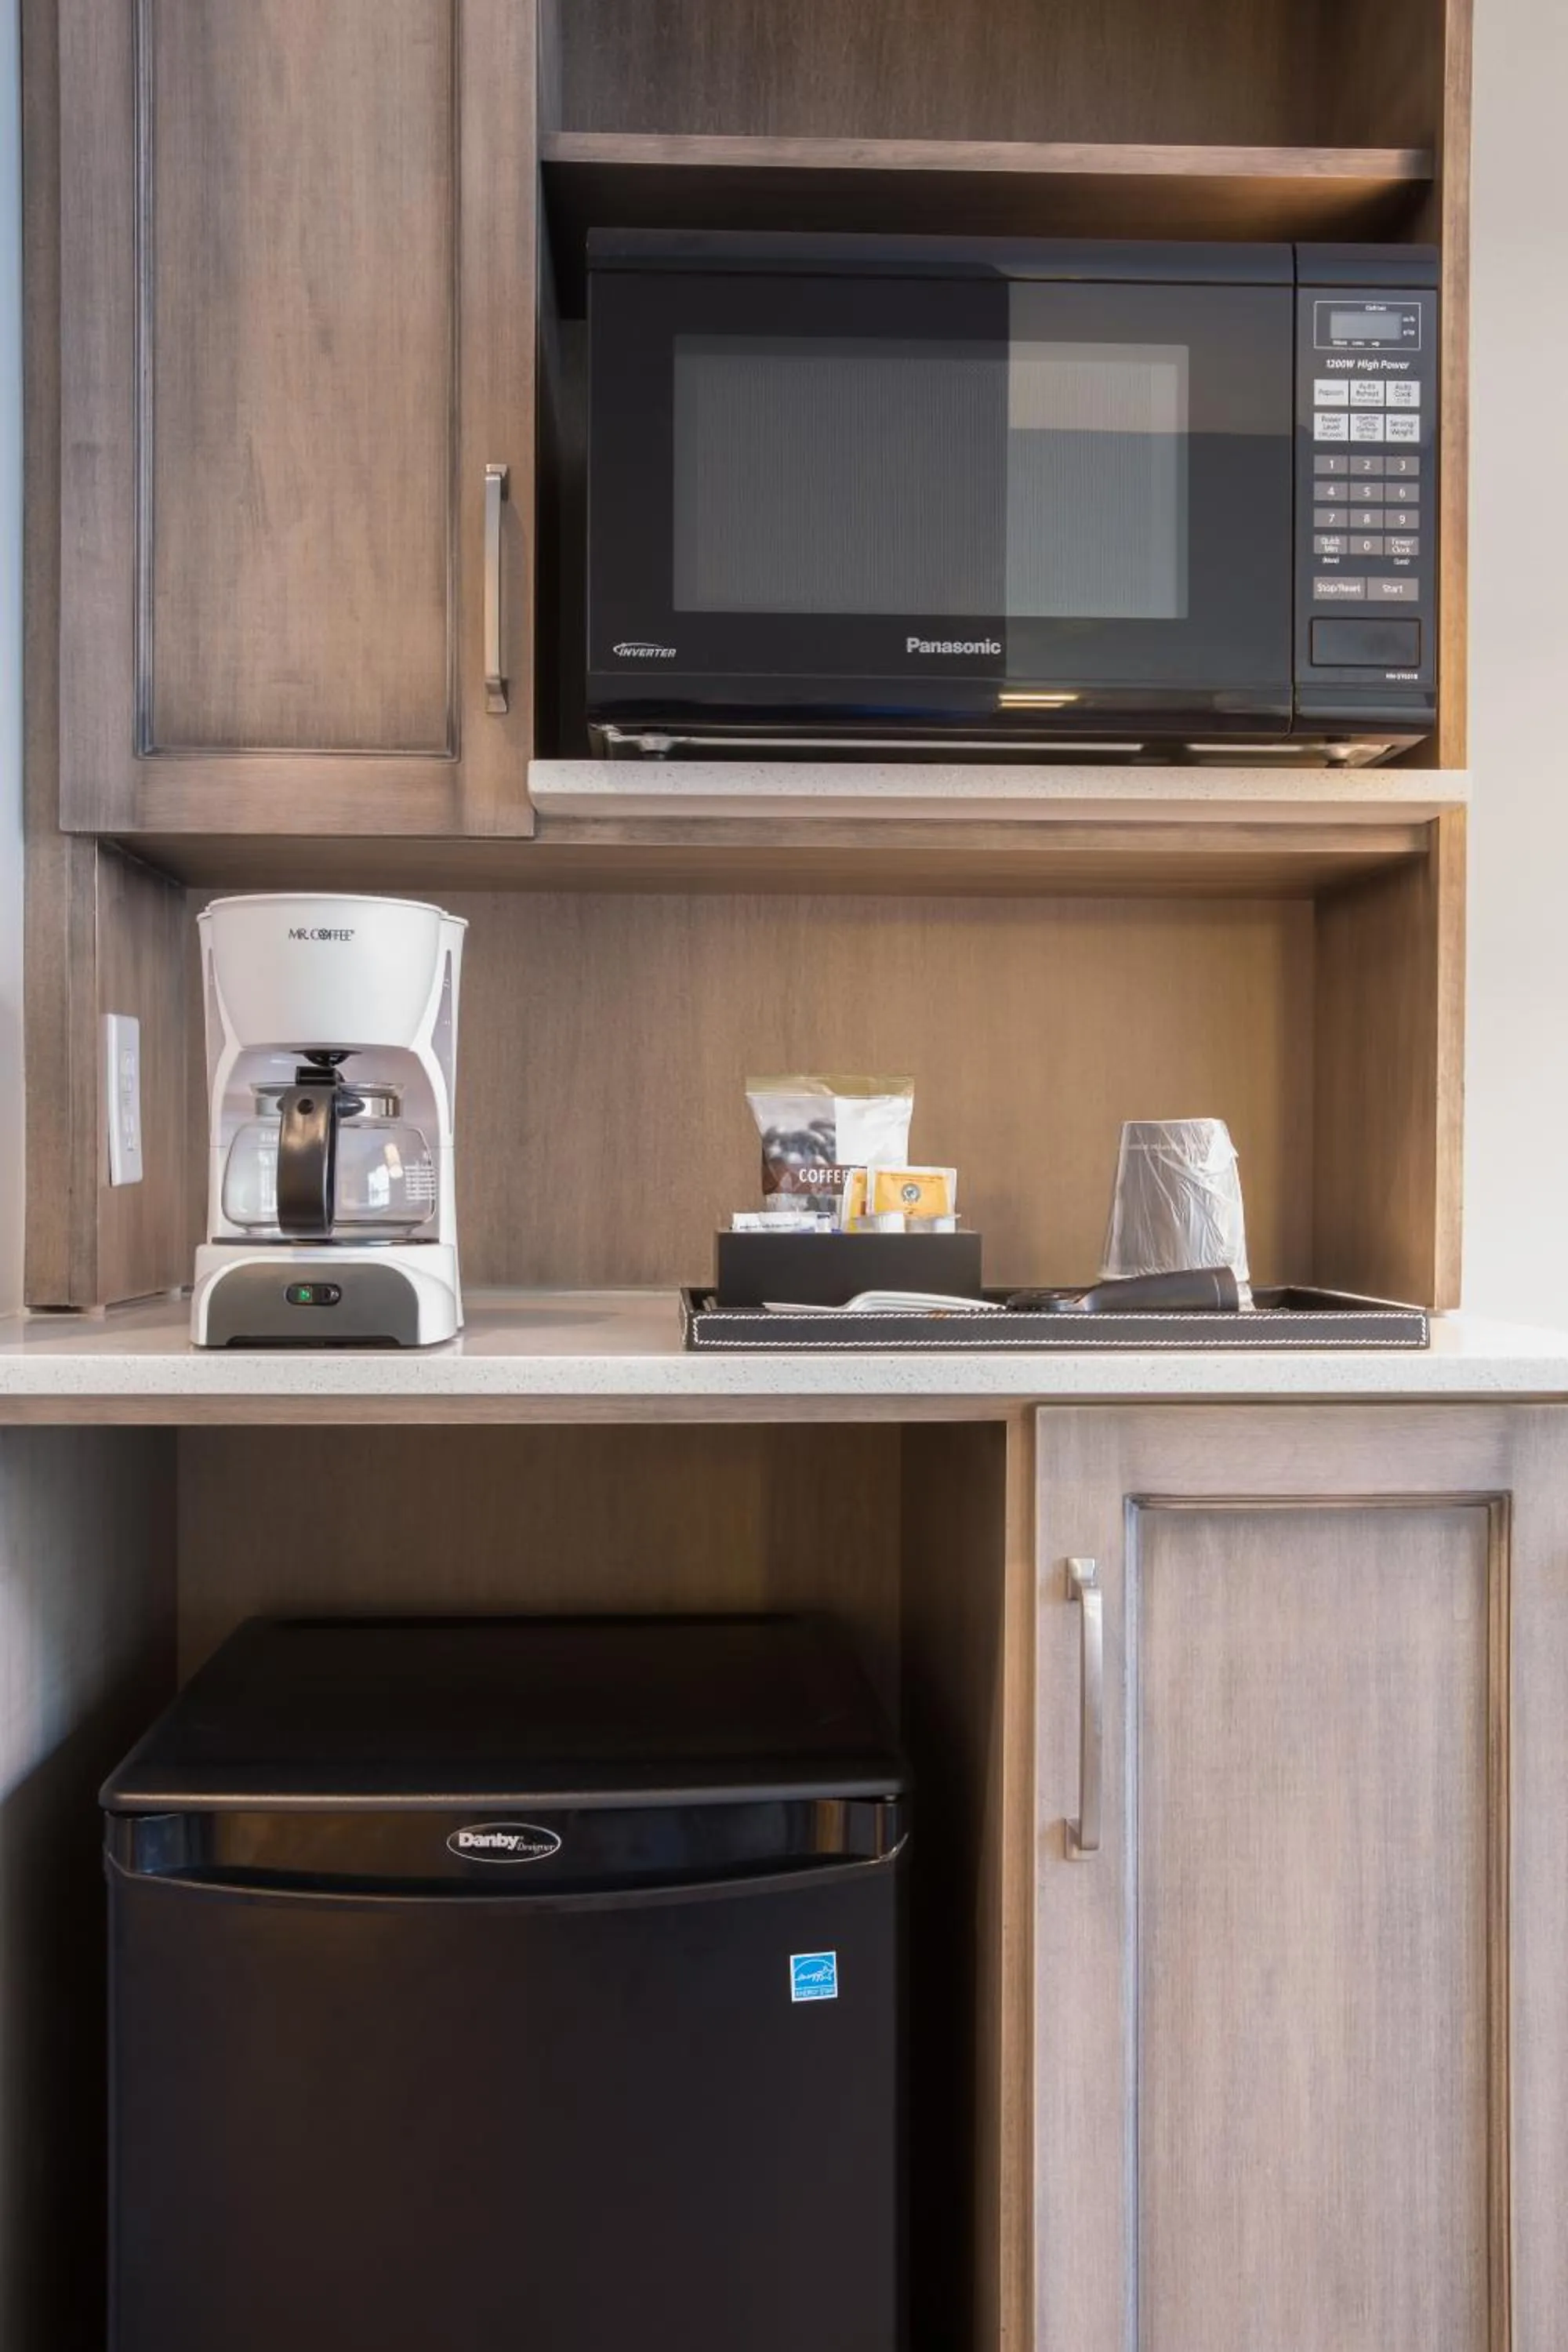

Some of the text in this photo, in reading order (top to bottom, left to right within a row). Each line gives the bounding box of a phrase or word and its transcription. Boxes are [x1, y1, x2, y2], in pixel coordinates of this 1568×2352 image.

[1327, 359, 1410, 371] 1200W High Power
[1330, 459, 1334, 470] 1
[1363, 459, 1371, 470] 2
[1399, 460, 1406, 471] 3
[1327, 486, 1335, 495] 4
[1363, 487, 1370, 497] 5
[1399, 488, 1406, 499] 6
[1329, 514, 1335, 524] 7
[1363, 514, 1370, 524] 8
[1399, 514, 1406, 524] 9
[1363, 540, 1370, 551] 0
[1382, 583, 1403, 593] Start
[906, 637, 1001, 654] Panasonic
[616, 646, 677, 658] INVERTER
[459, 1832, 521, 1850] Danby
